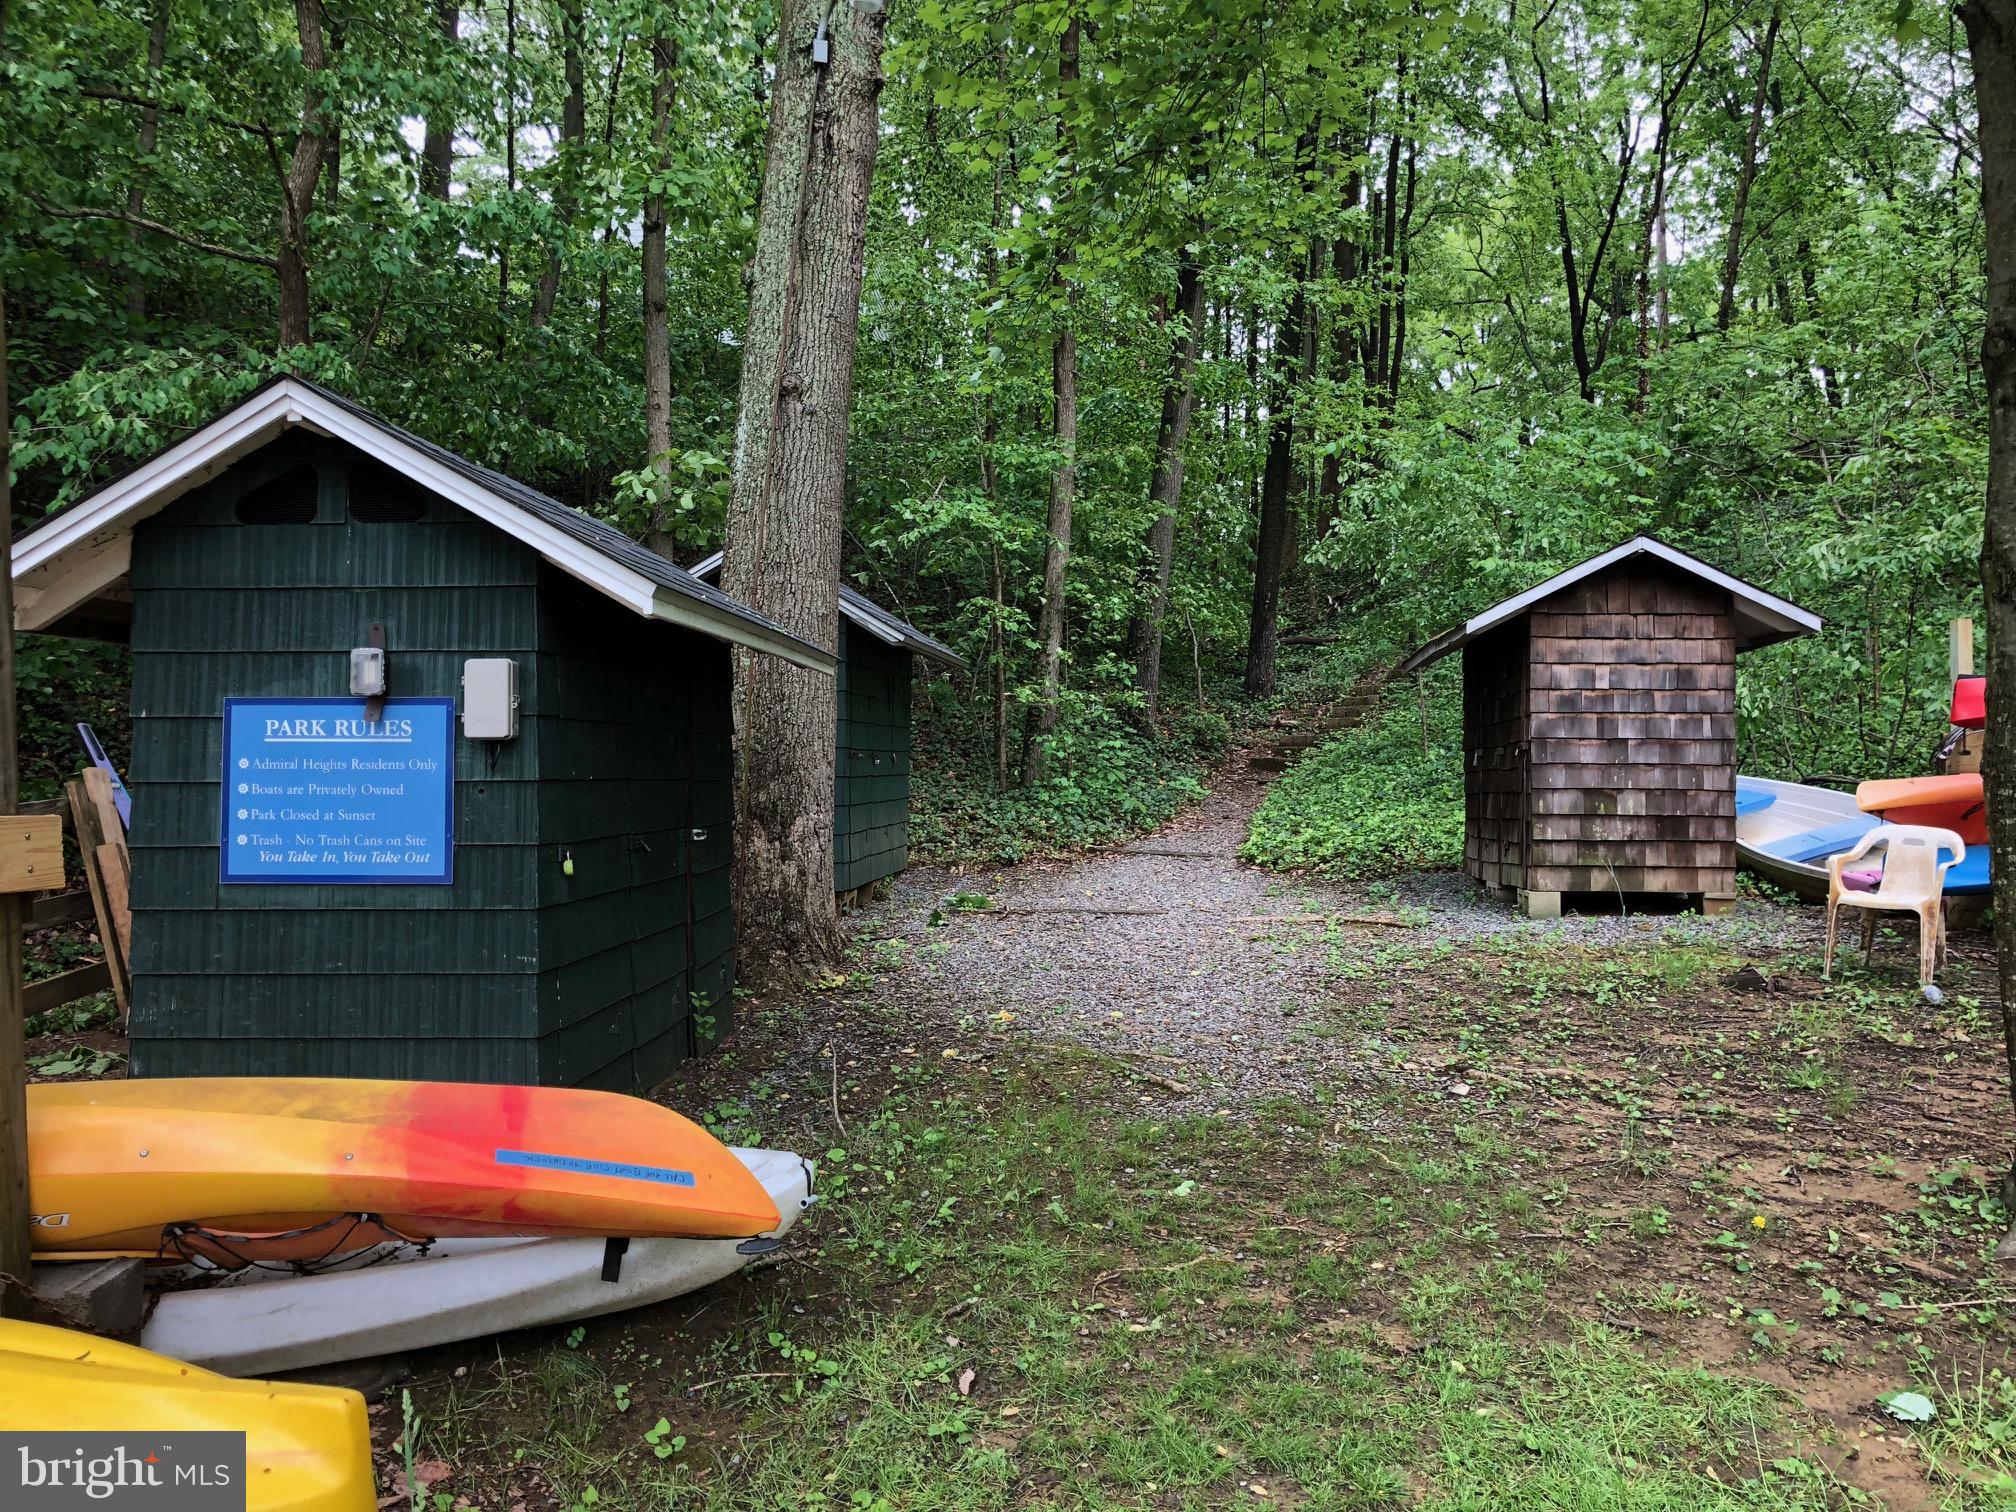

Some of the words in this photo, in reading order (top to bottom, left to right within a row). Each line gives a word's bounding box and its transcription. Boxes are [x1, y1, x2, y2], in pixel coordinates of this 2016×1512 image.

[265, 720, 326, 736] PARK
[335, 720, 412, 737] RULES
[253, 758, 298, 769] Admiral
[303, 758, 346, 773] Heights
[351, 758, 405, 770] Residents
[409, 758, 437, 773] Only
[252, 784, 283, 795] Boats
[287, 786, 303, 795] are
[309, 784, 357, 798] Privately
[362, 784, 403, 795] Owned
[251, 809, 275, 819] Park
[280, 809, 319, 820] Closed
[324, 811, 333, 820] at
[338, 810, 376, 821] Sunset
[250, 835, 282, 845] Trash
[296, 835, 313, 846] No
[318, 835, 349, 846] Trash
[354, 835, 382, 846] Cans
[386, 838, 401, 846] on
[405, 835, 426, 846] Site
[260, 851, 282, 863] You
[288, 851, 317, 863] Take
[322, 851, 338, 864] In,
[343, 851, 366, 863] You
[371, 851, 400, 863] Take
[405, 851, 430, 863] Out
